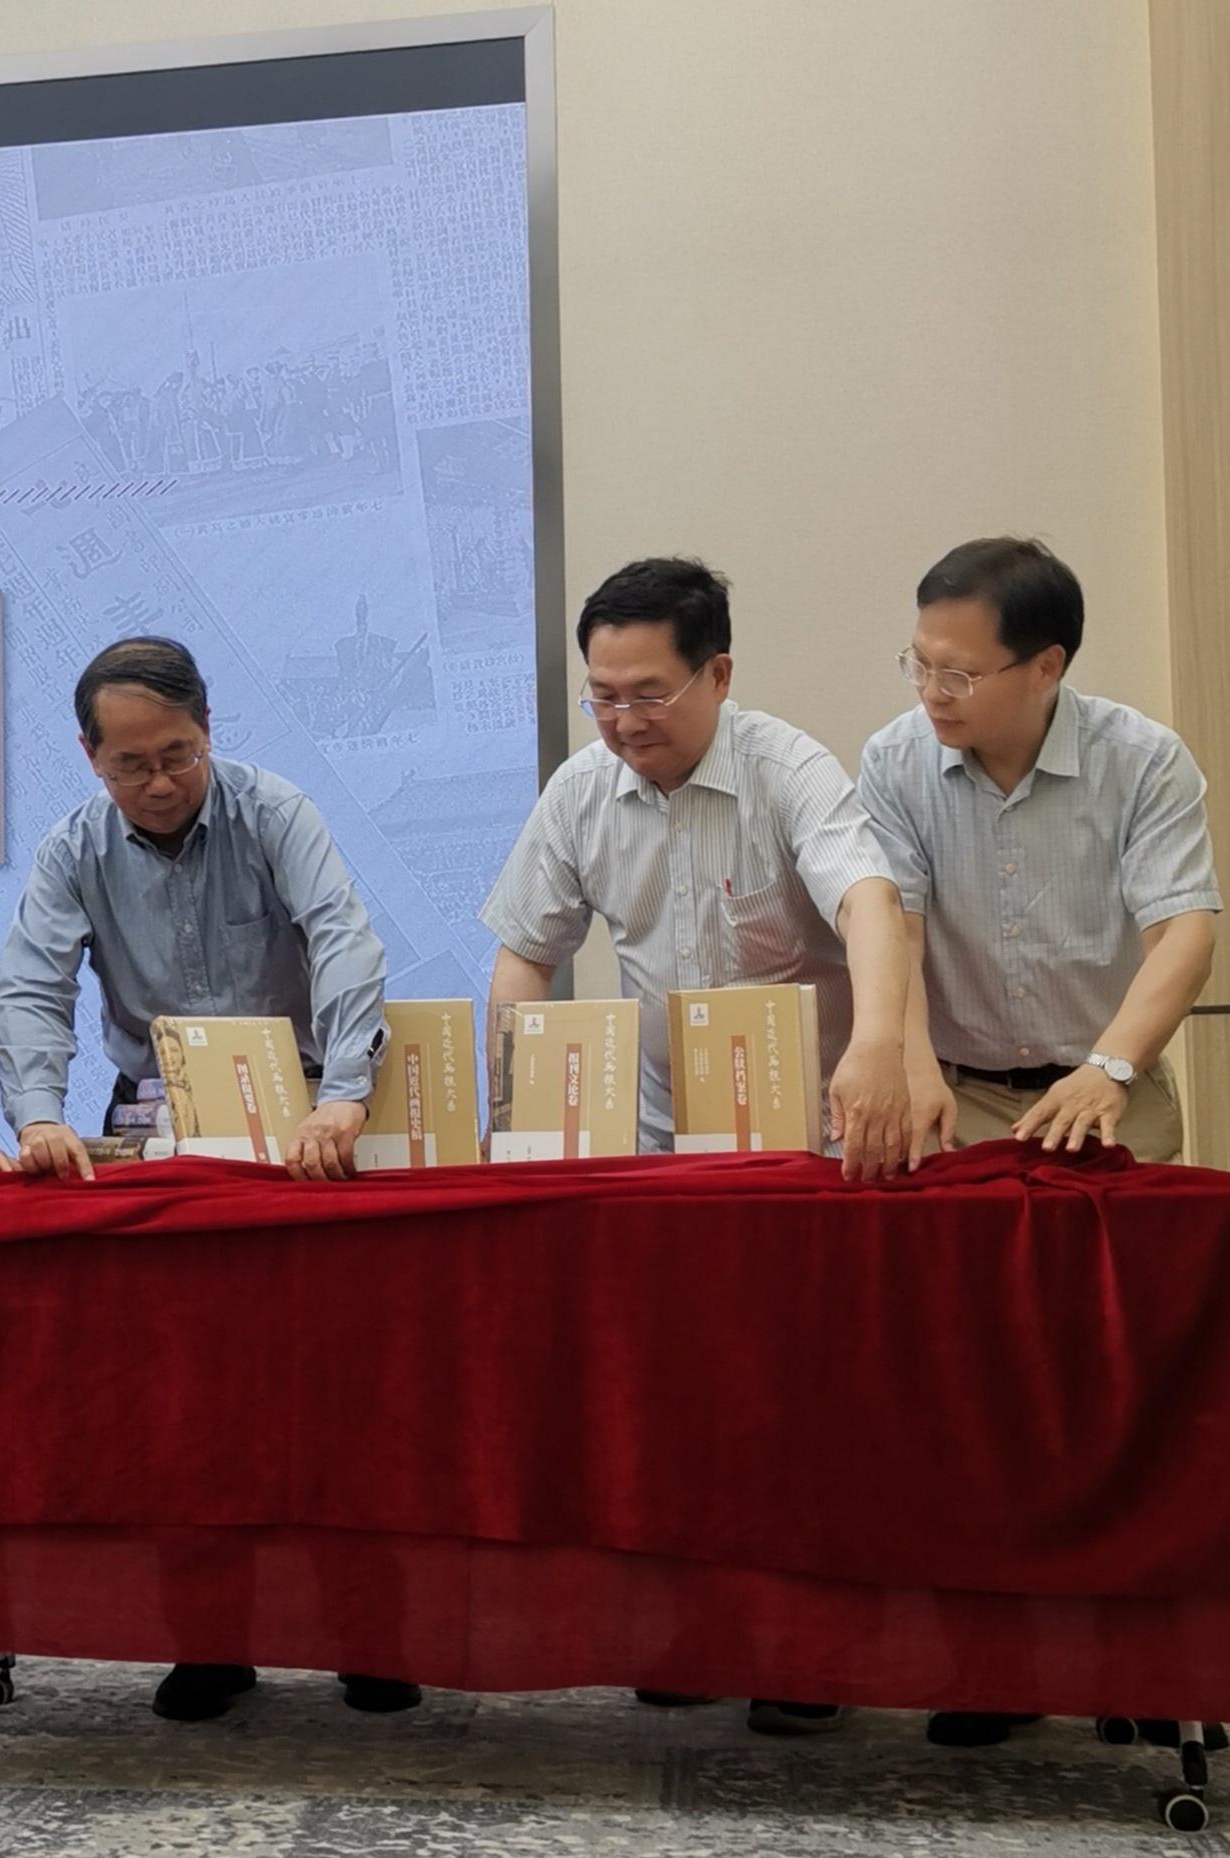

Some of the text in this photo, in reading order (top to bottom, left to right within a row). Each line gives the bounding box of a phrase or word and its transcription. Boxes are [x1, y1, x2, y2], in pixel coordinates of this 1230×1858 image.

[407, 1053, 423, 1140] 中国近代画报史稿
